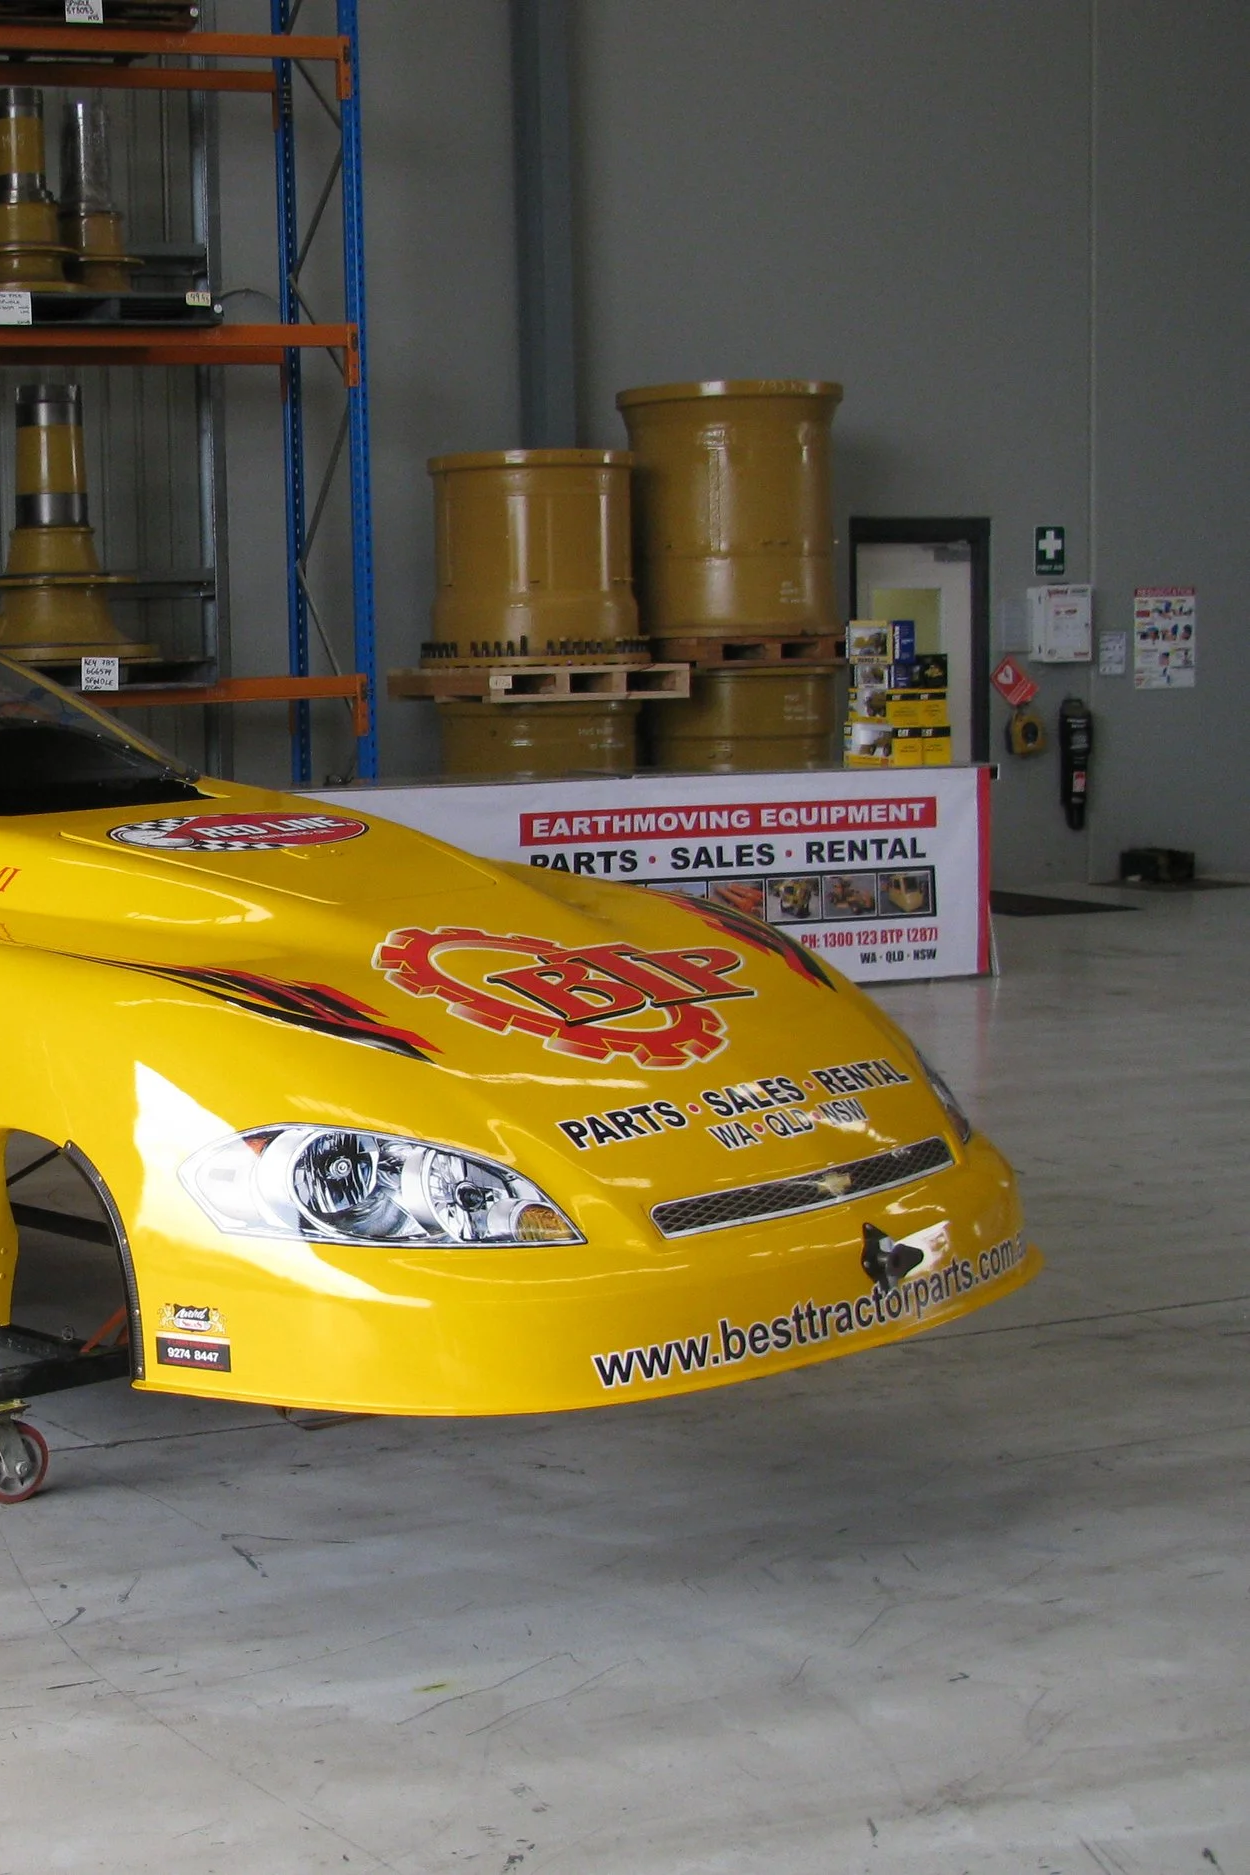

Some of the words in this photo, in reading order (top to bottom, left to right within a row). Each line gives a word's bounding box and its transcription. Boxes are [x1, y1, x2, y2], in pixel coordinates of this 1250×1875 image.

[193, 822, 268, 838] RED
[260, 816, 346, 832] LINE
[532, 809, 750, 839] EARTHMOVING
[760, 803, 925, 828] EQUIPMENT
[530, 849, 639, 875] PARTS
[670, 843, 775, 869] SALES
[806, 837, 926, 863] RENTAL
[801, 933, 820, 948] PH:
[823, 931, 853, 948] 1300
[857, 930, 877, 946] 123
[880, 928, 903, 944] BTP
[907, 927, 938, 943] (287)
[860, 952, 877, 964] WA
[885, 950, 904, 963] QLD
[913, 948, 937, 961] NSW
[486, 942, 756, 1027] BTP
[556, 1100, 688, 1151] PARTS
[700, 1076, 807, 1118] SALES
[809, 1058, 910, 1096] RENTAL
[707, 1122, 761, 1150] WA
[764, 1108, 816, 1139] QLD
[815, 1098, 868, 1125] NSW
[167, 1346, 190, 1359] 9274
[194, 1349, 219, 1362] 8447
